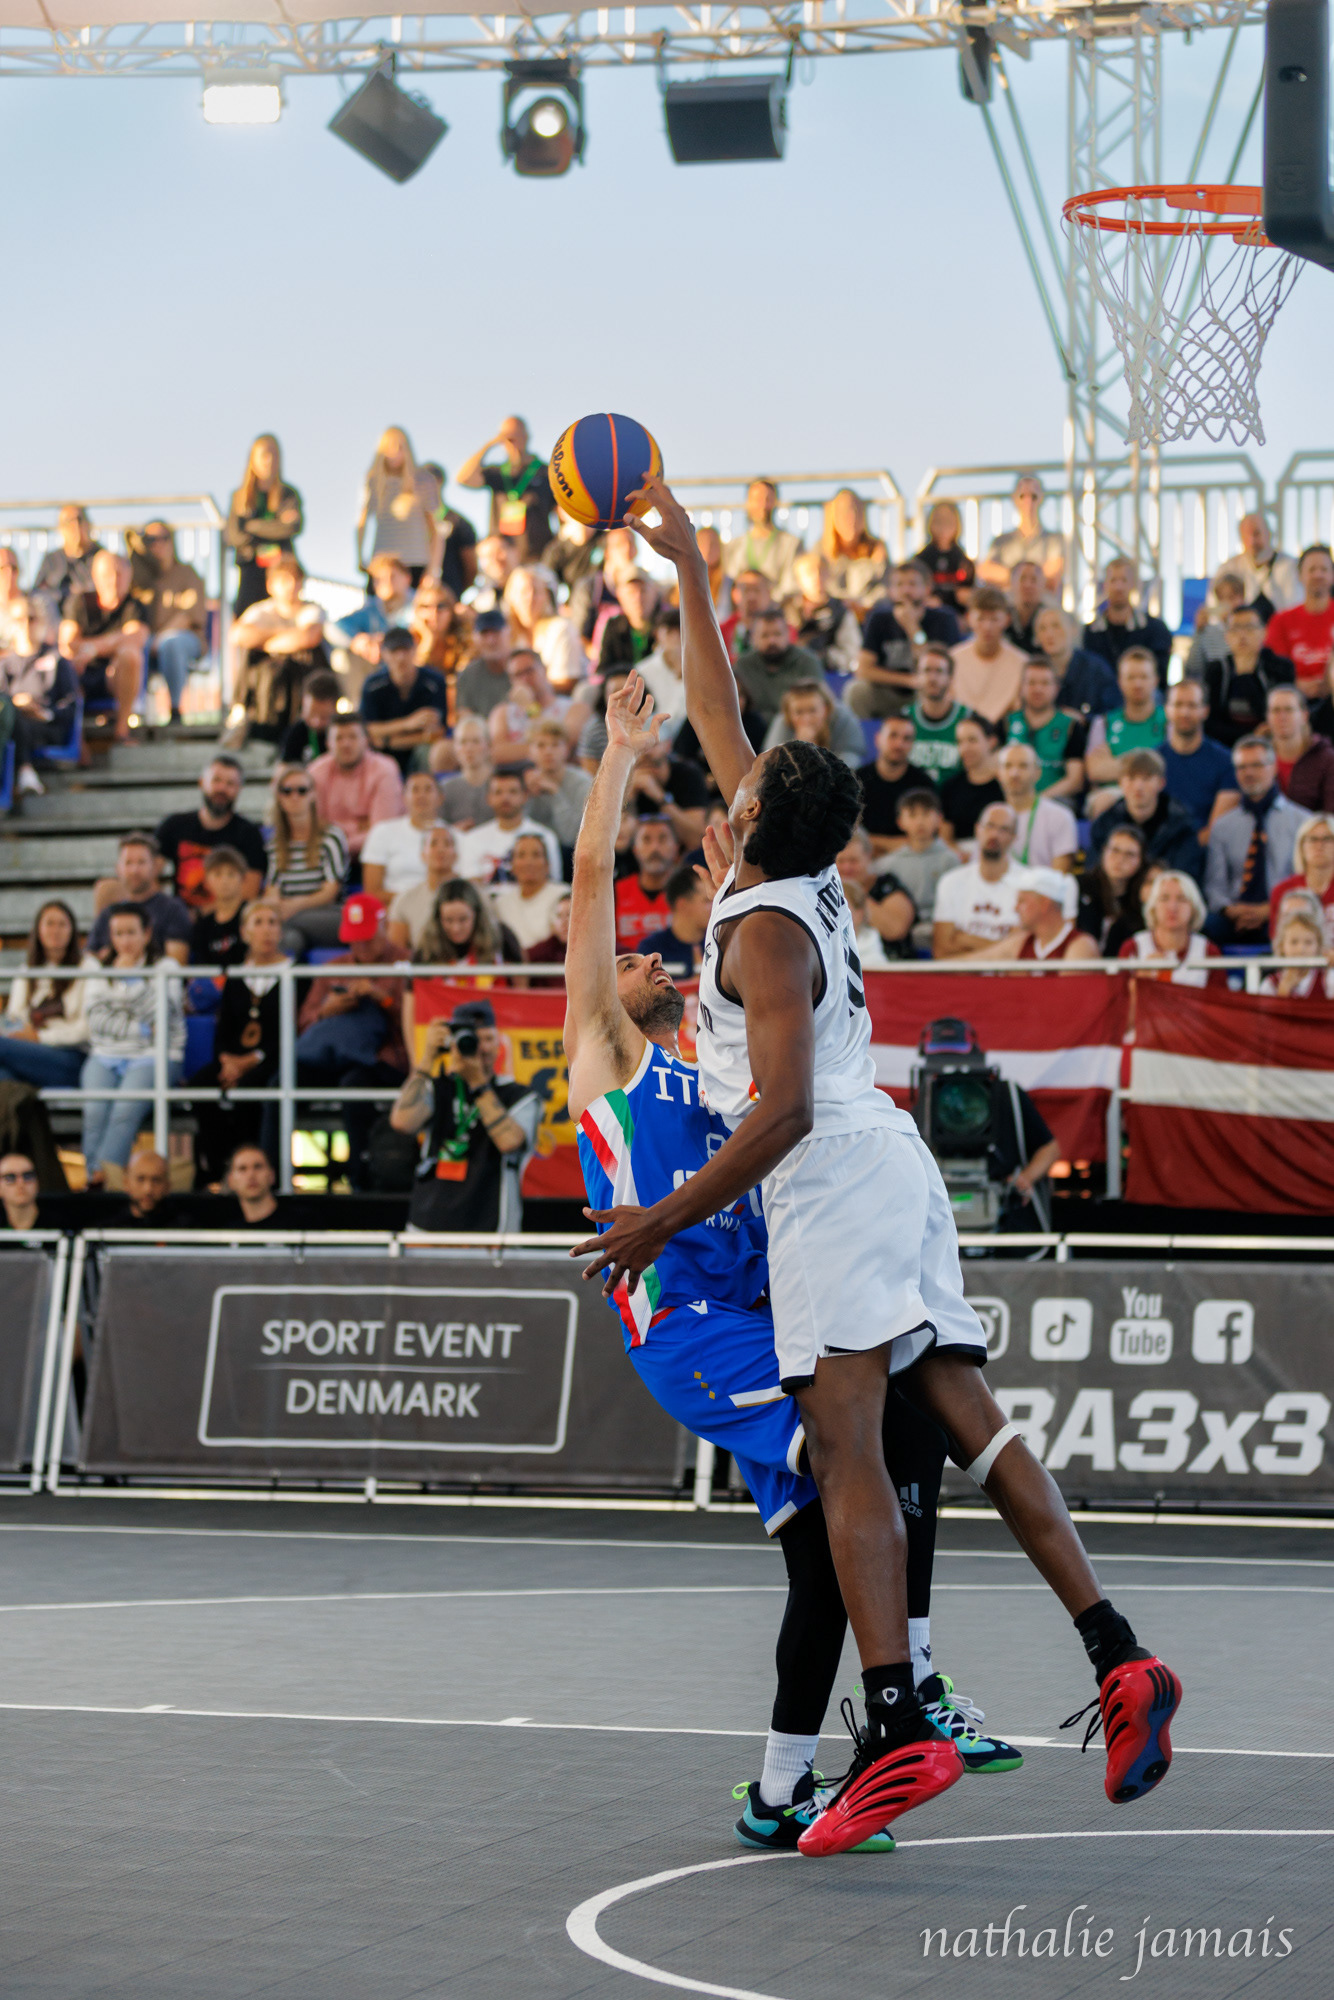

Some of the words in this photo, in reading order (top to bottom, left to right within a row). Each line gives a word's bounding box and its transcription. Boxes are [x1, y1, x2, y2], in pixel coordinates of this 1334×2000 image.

[1121, 1286, 1163, 1319] You
[260, 1319, 386, 1356] SPORT
[394, 1321, 523, 1359] EVENT
[1117, 1327, 1167, 1357] Tube
[286, 1378, 482, 1418] DENMARK
